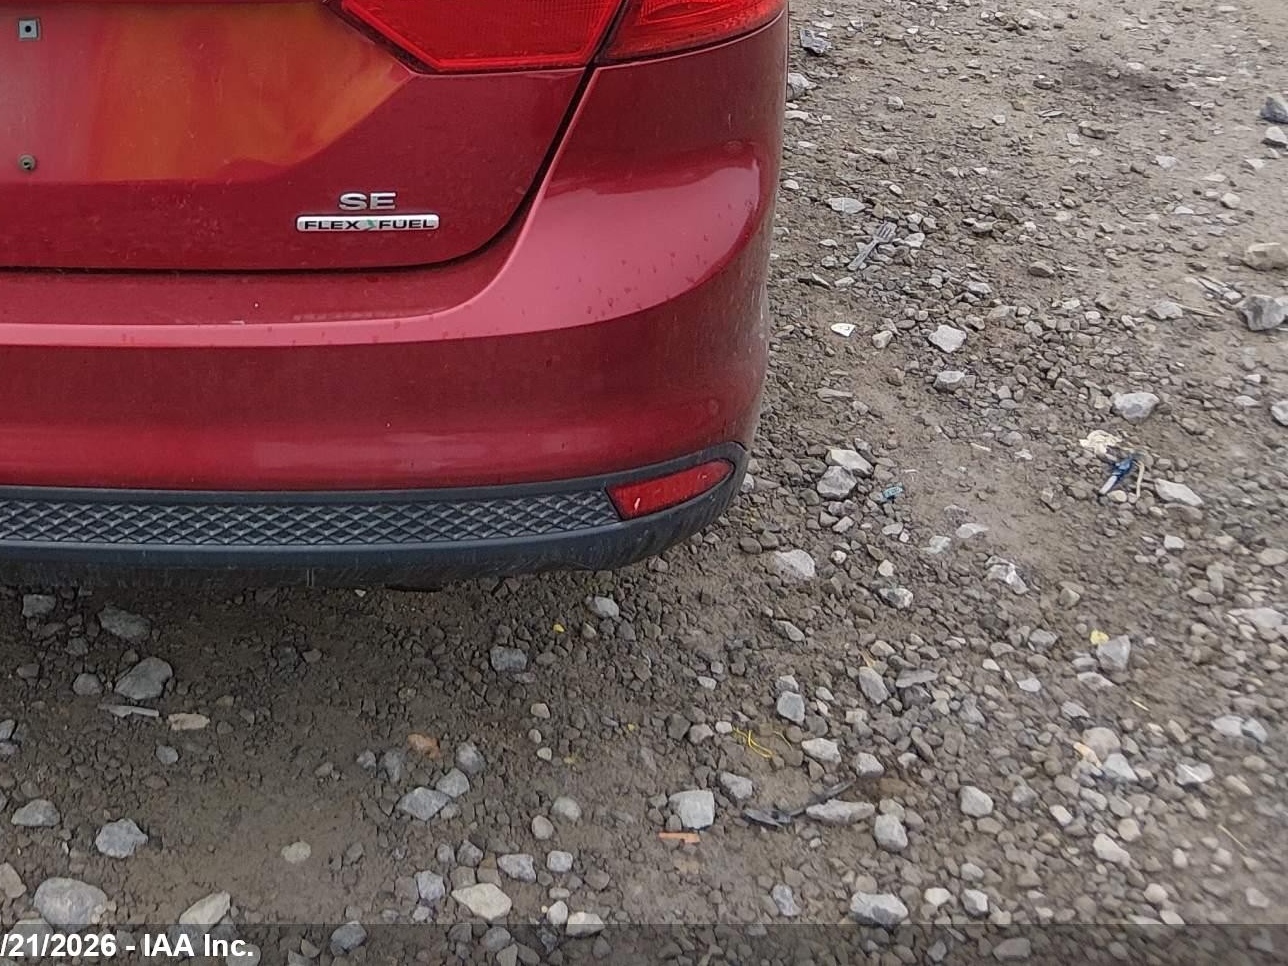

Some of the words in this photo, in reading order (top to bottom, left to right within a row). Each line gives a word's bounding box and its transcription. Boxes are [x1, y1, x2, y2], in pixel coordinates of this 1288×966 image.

[338, 192, 397, 211] SE
[304, 220, 361, 230] FLEX
[378, 219, 435, 230] FUEL
